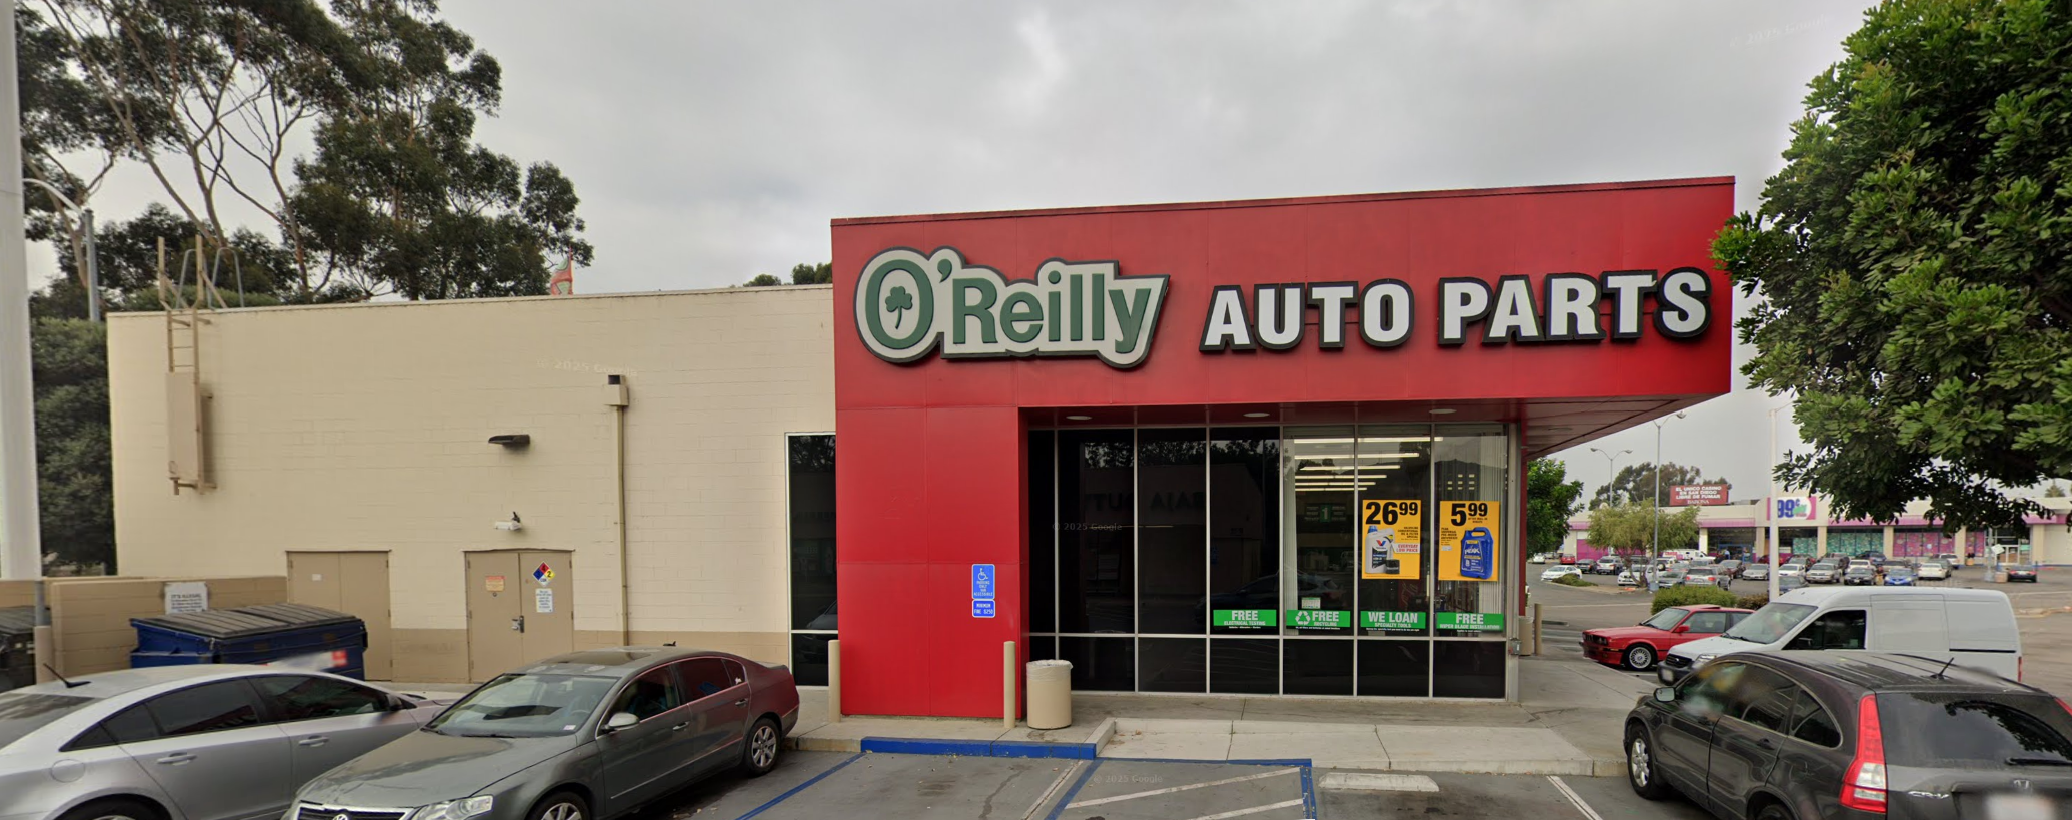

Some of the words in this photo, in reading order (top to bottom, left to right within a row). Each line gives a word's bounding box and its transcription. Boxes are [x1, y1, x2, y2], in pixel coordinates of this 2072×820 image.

[863, 257, 1153, 355] O'Reilly
[1203, 280, 1412, 350] AUTO
[1441, 269, 1709, 343] PARTS
[547, 570, 552, 578] 2
[1231, 610, 1259, 621] FREE
[1312, 610, 1340, 622] FREE
[1368, 611, 1385, 622] WE
[1389, 612, 1418, 623] LOAN
[1456, 613, 1484, 624] FREE
